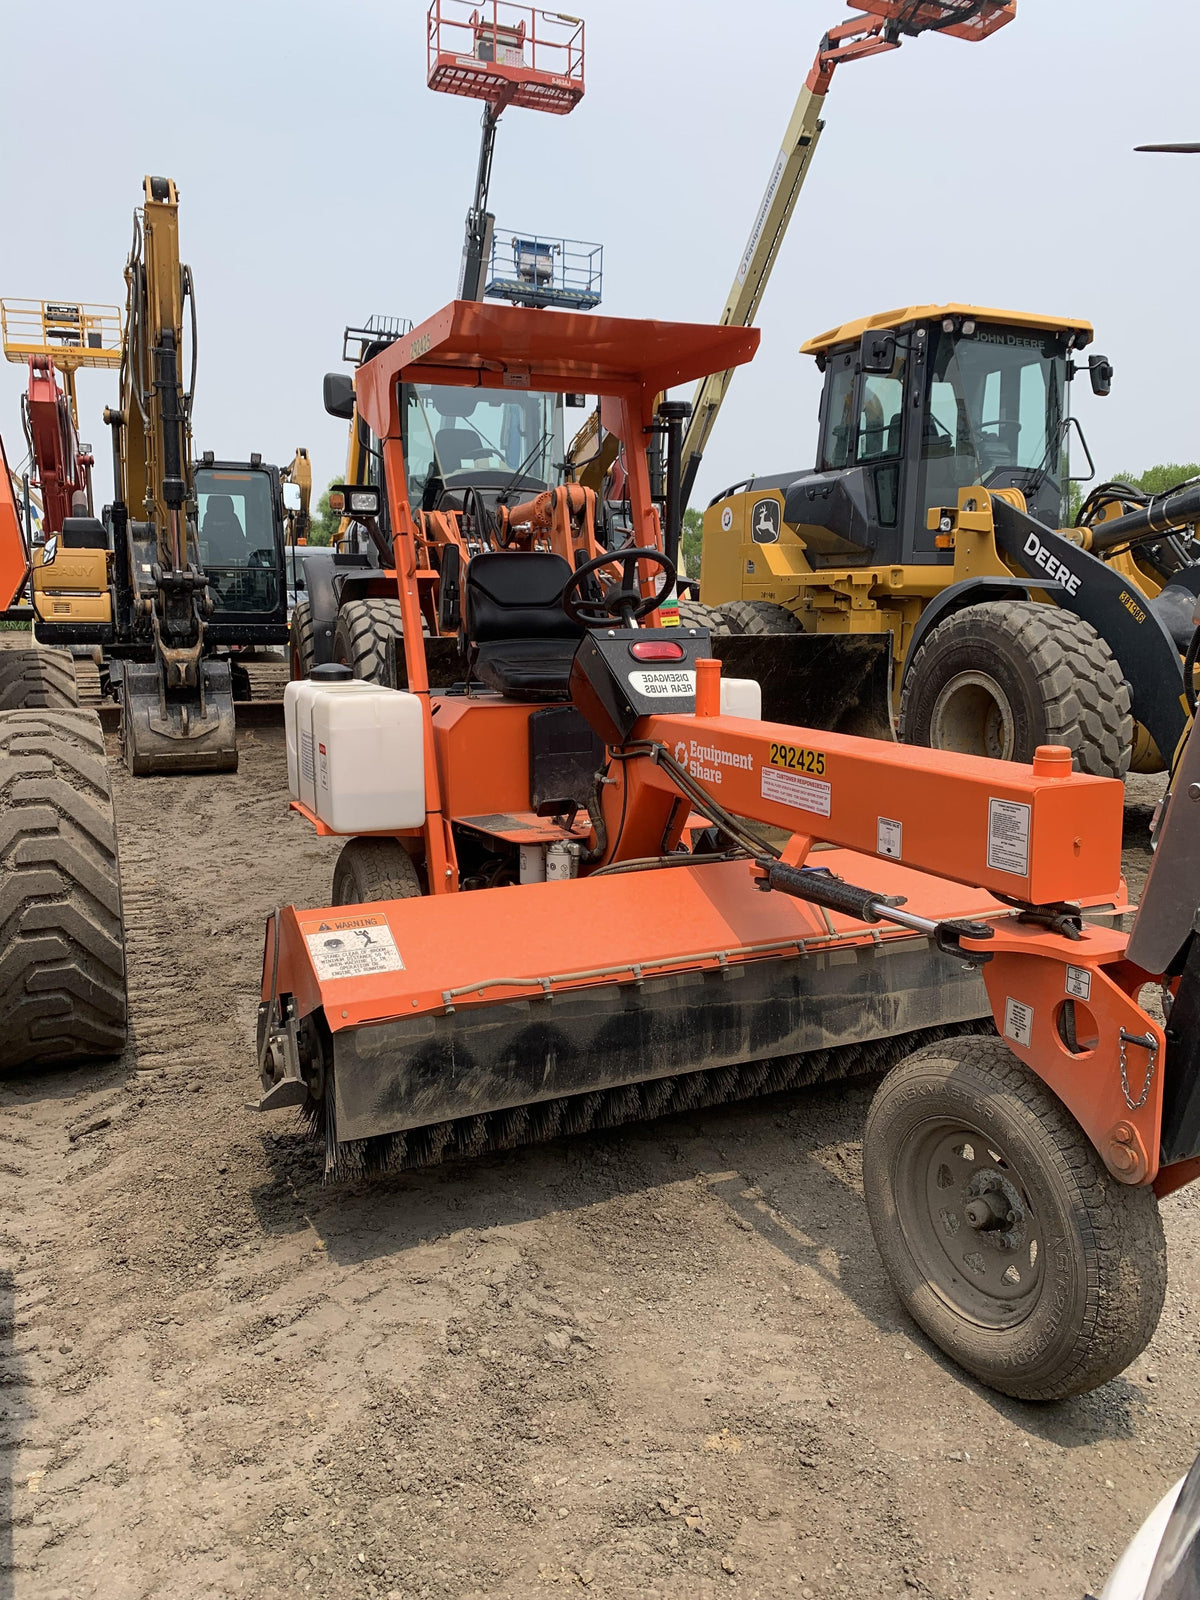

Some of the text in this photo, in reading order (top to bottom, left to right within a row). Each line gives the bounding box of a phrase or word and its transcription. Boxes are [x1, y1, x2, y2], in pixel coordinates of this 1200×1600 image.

[974, 331, 1046, 349] JOHN DEERE
[45, 565, 95, 577] SANY
[1023, 532, 1082, 596] DEERE
[1120, 591, 1146, 624] 301906
[690, 740, 753, 770] Equipment
[770, 743, 825, 775] 292425
[690, 760, 722, 784] Share
[334, 918, 378, 930] WARNING
